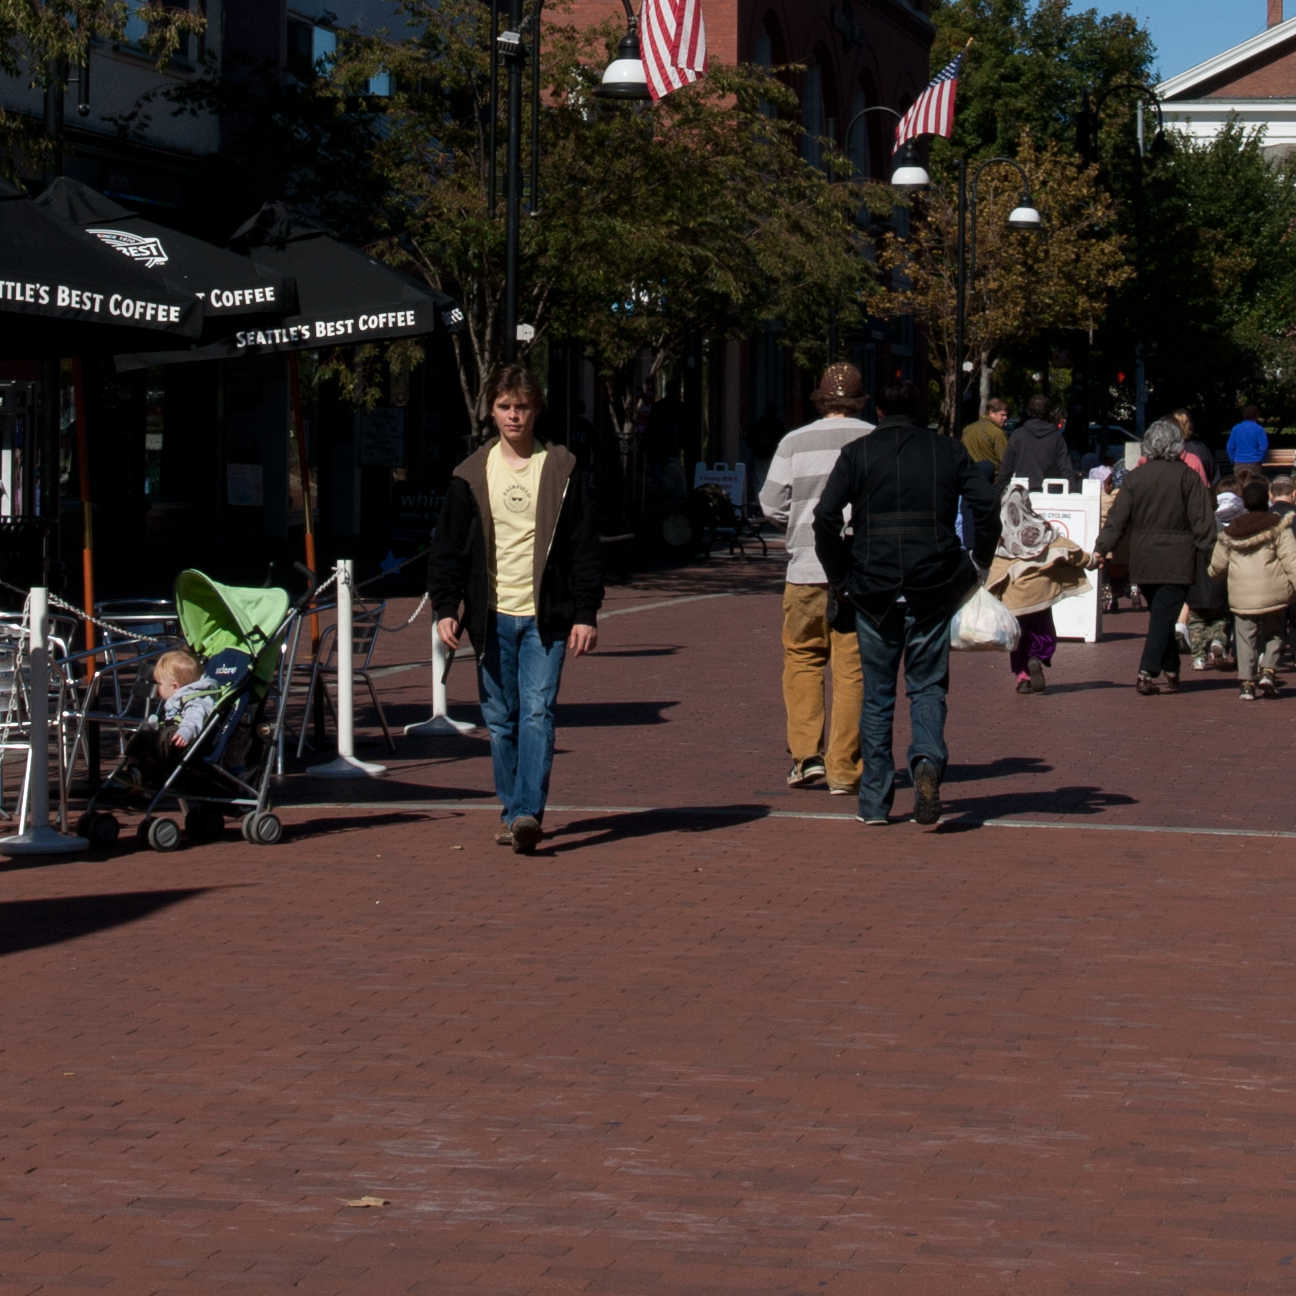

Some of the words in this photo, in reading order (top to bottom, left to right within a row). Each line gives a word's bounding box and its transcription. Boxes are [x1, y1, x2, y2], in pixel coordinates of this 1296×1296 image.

[56, 284, 104, 313] BEST
[109, 294, 181, 323] COFFEE
[210, 286, 275, 308] COFFEE
[236, 323, 310, 348] SEATTLE'S
[314, 319, 355, 338] BEST
[358, 310, 416, 331] COFFEE
